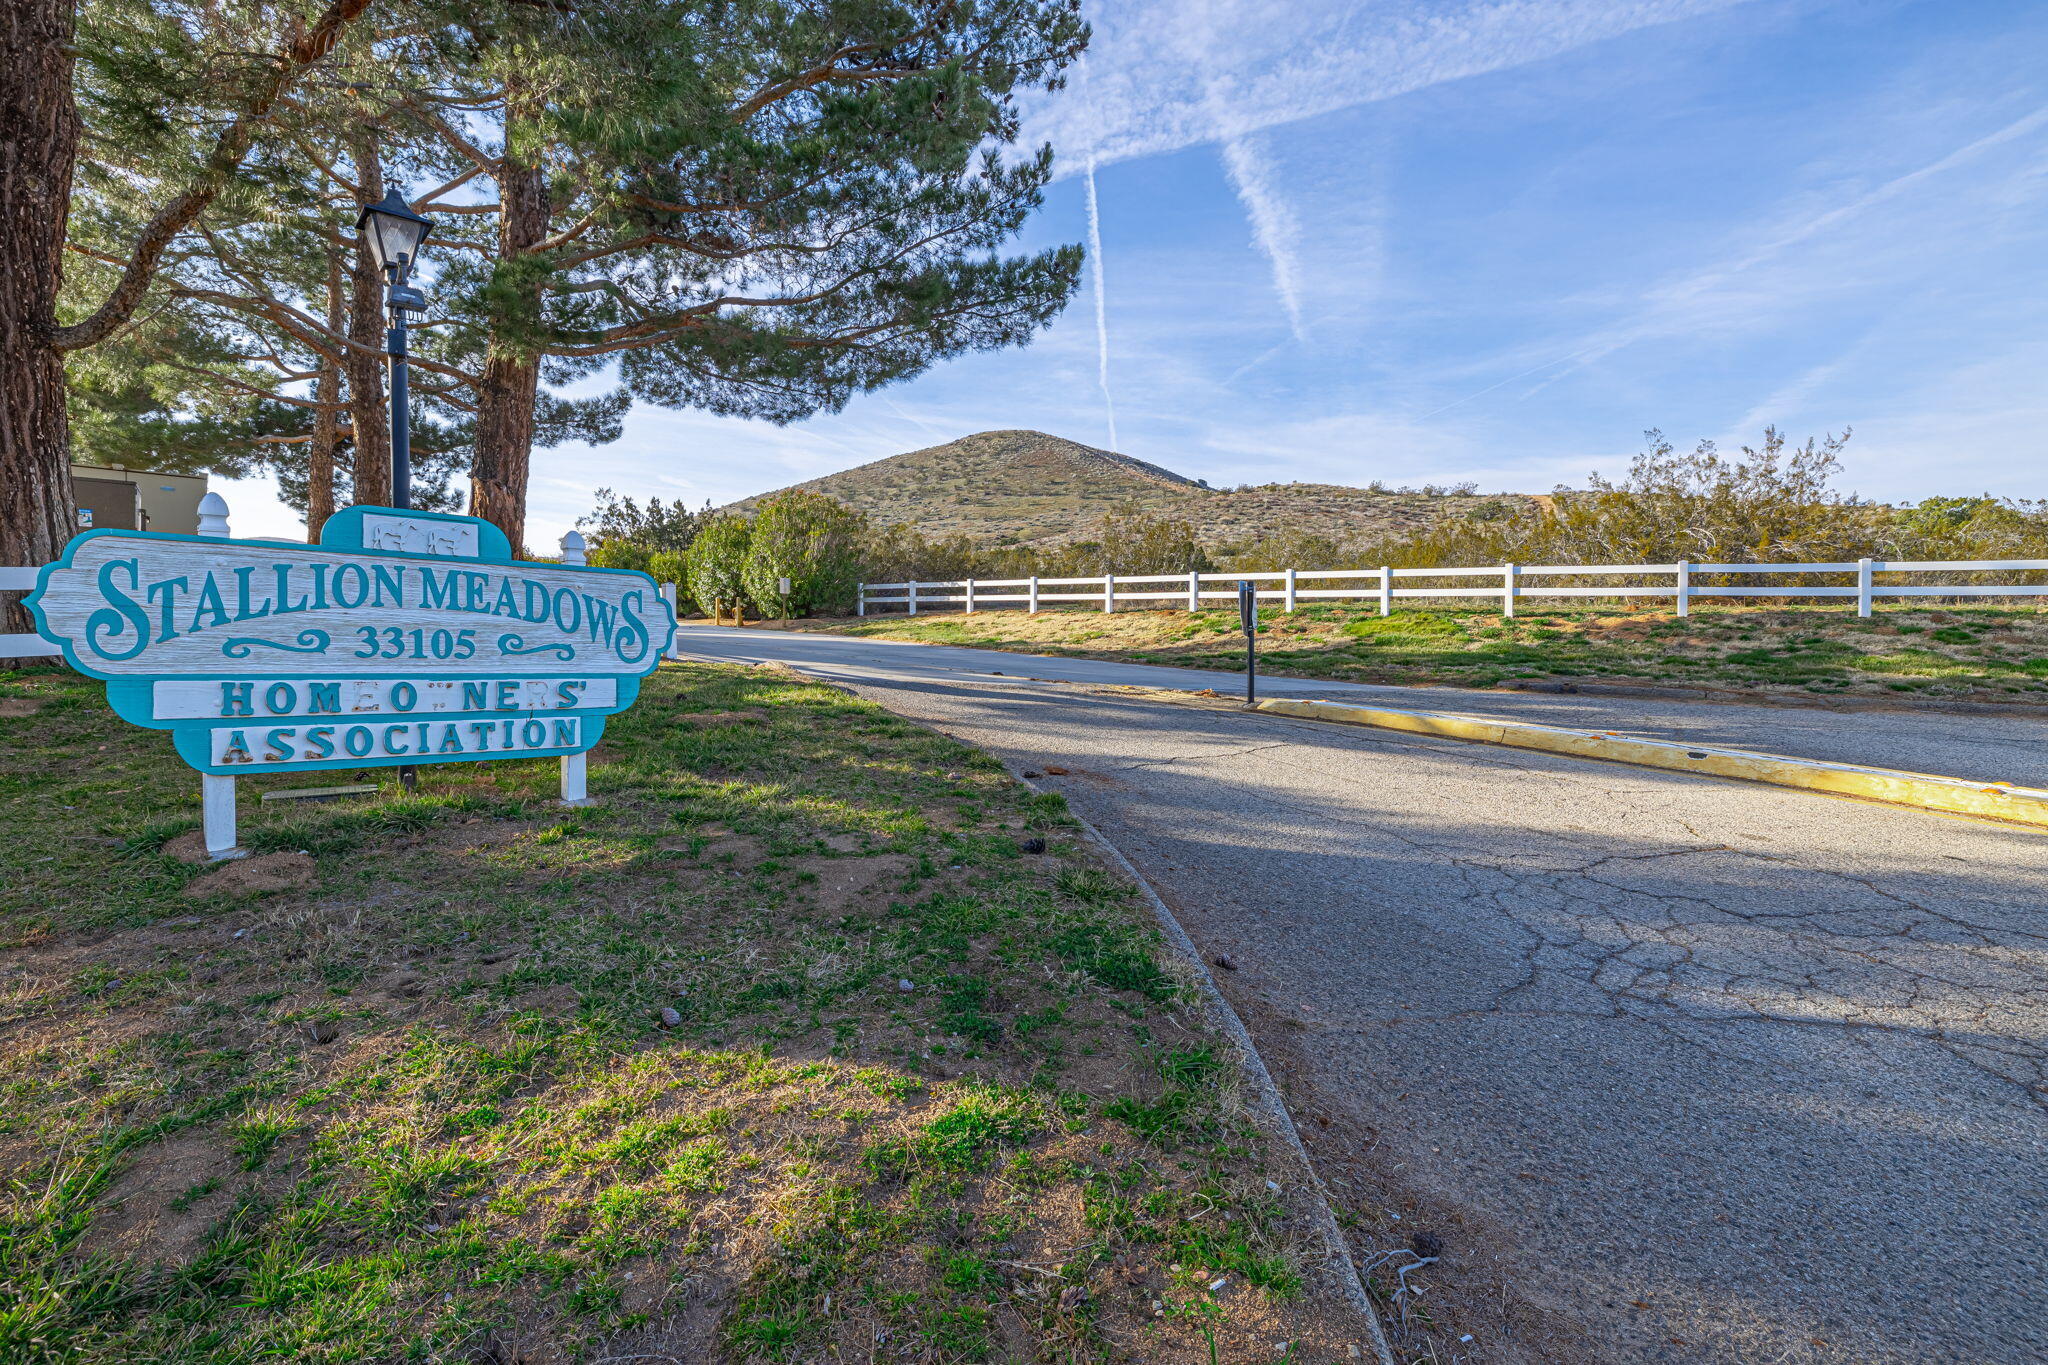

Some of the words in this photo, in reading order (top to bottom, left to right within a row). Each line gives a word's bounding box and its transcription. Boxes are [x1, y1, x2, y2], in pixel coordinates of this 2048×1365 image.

[86, 558, 405, 661] STALLION
[418, 566, 649, 663] MEADOWS
[354, 627, 476, 659] 33105
[222, 719, 577, 763] ASSOCIATION
